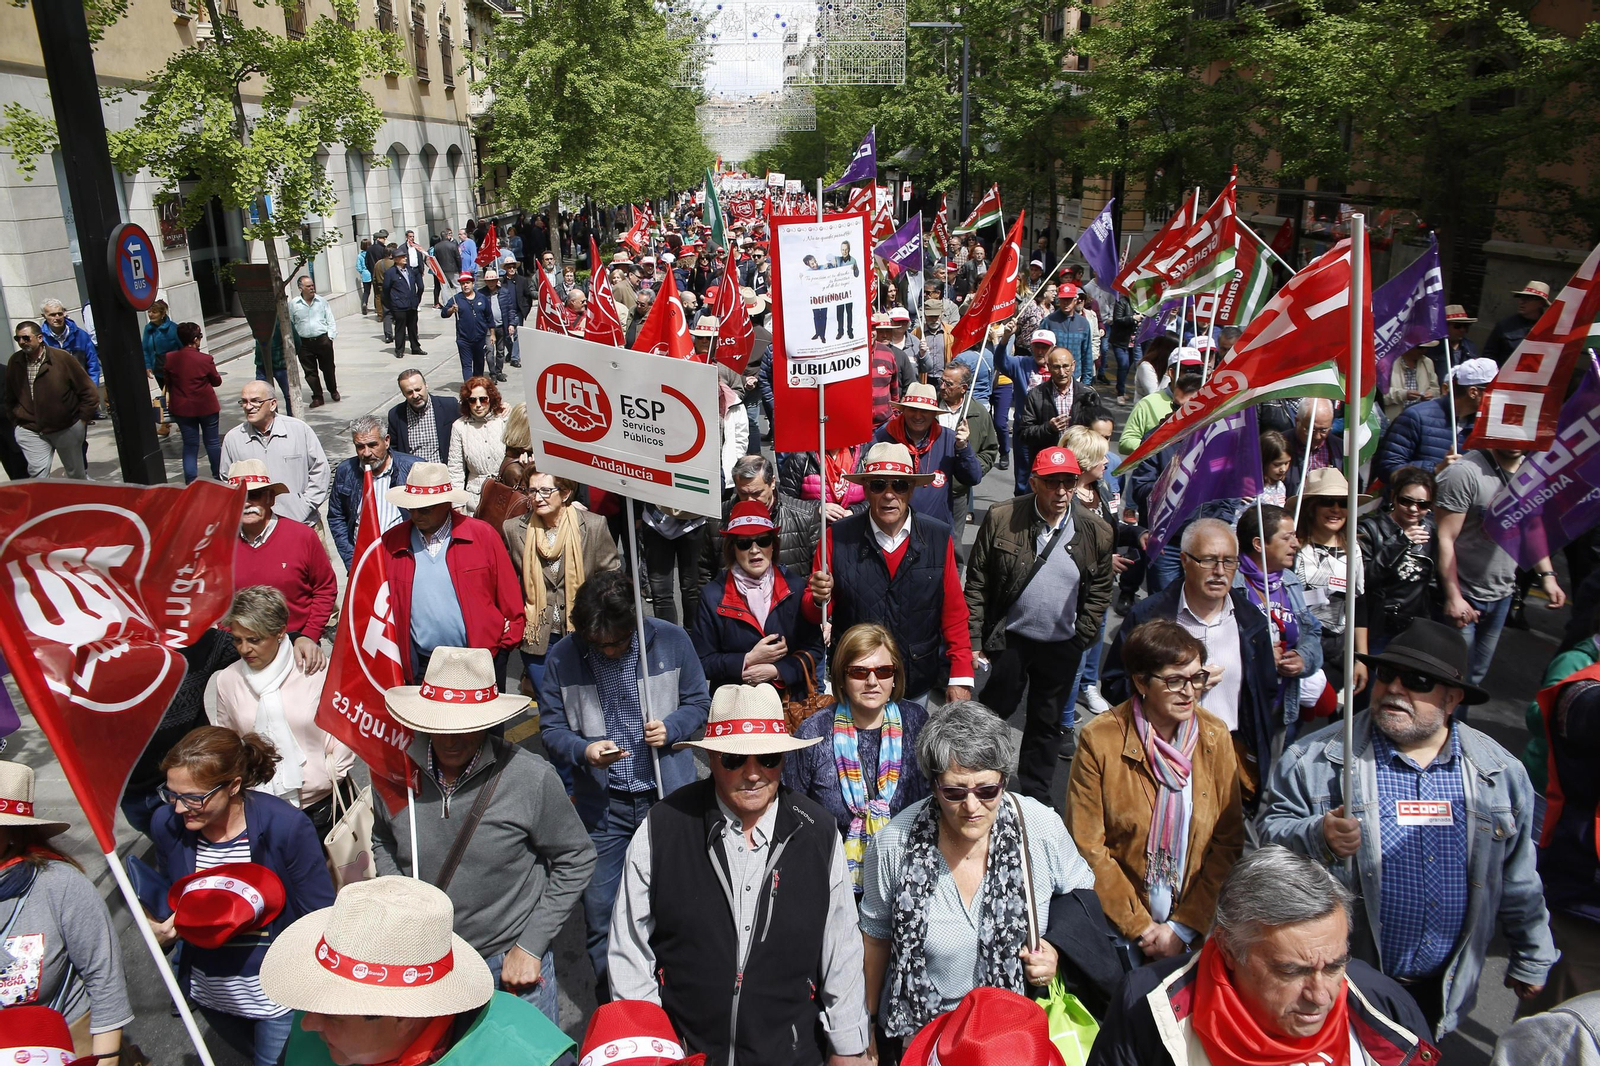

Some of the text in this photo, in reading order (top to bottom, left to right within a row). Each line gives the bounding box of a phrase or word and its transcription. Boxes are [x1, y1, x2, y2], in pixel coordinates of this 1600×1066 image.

[134, 259, 141, 277] P
[134, 280, 147, 289] BUS
[790, 354, 861, 376] JUBILADOS
[544, 373, 600, 415] UGT
[620, 394, 666, 422] FeSP
[622, 419, 666, 436] Servicios
[623, 430, 664, 447] Públicos
[590, 455, 654, 481] Andalucía
[6, 544, 150, 645] UGT
[792, 805, 815, 824] Quechua
